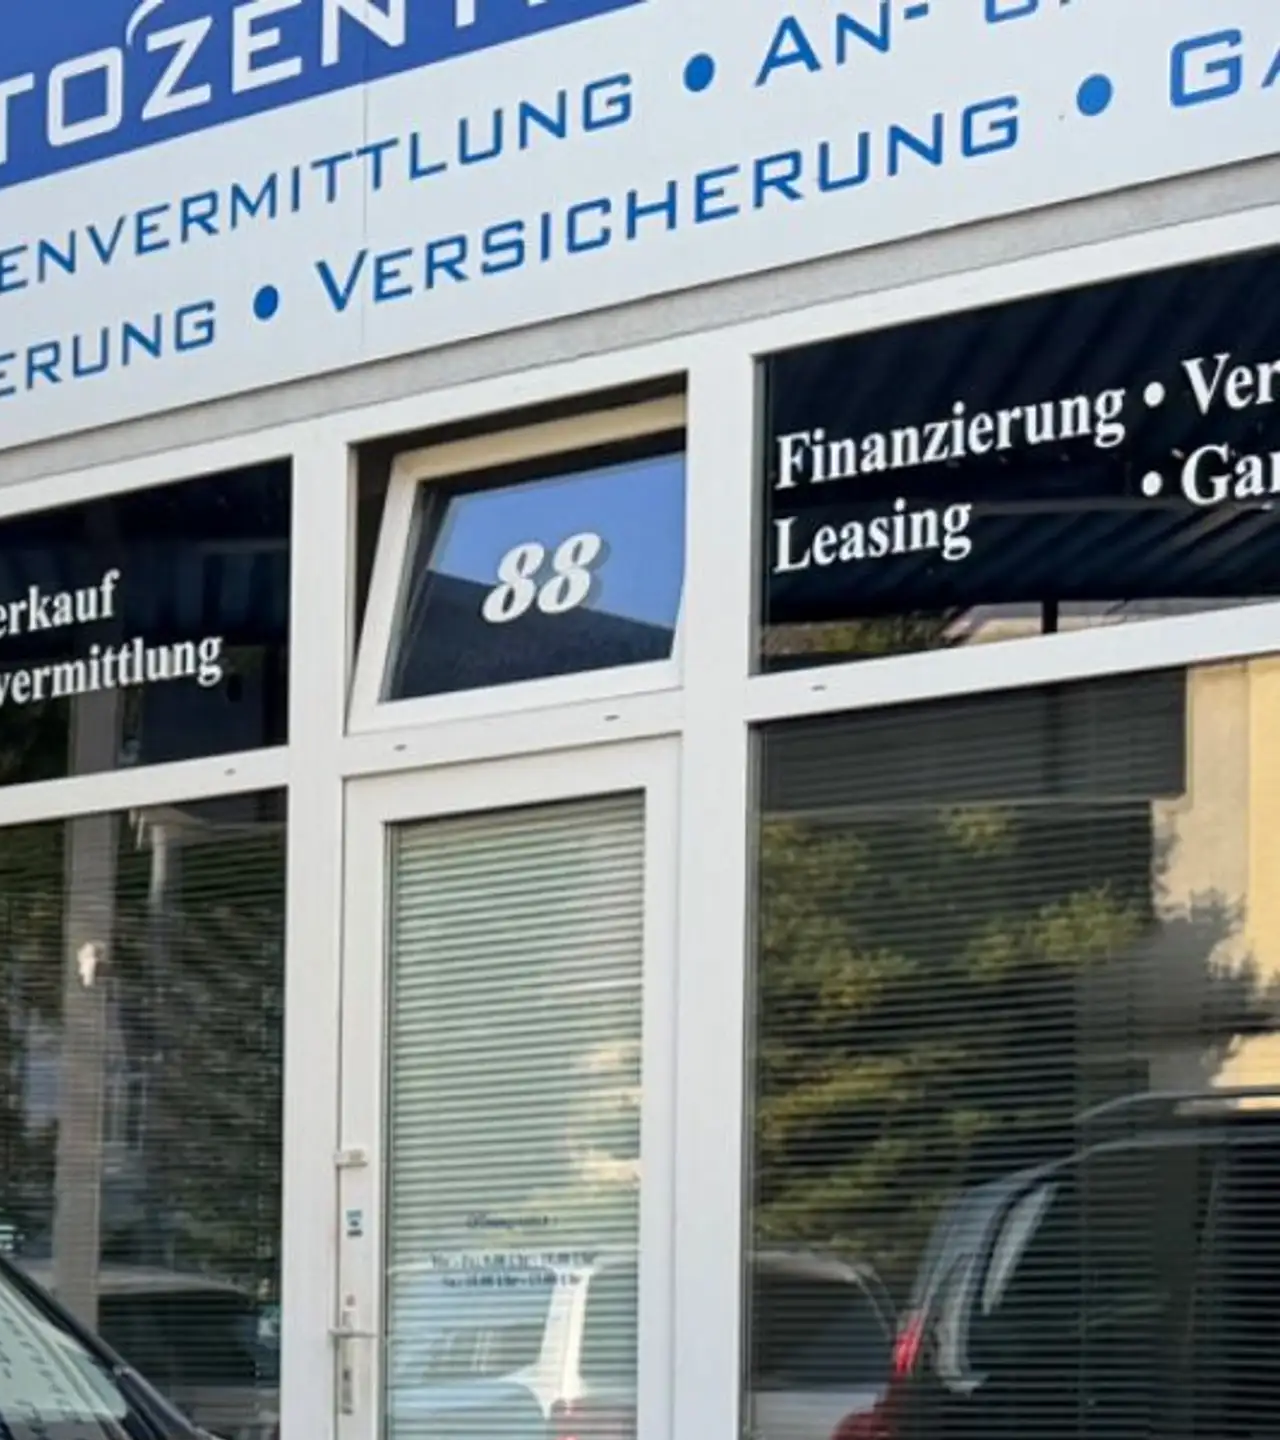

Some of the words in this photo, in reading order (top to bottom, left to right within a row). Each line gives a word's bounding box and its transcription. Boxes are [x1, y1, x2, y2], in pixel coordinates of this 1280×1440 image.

[315, 95, 1019, 312] VERSICHERUNG
[1170, 28, 1280, 108] G
[775, 388, 1127, 490] Finanzierung
[482, 532, 601, 622] 88
[774, 498, 973, 573] Leasing
